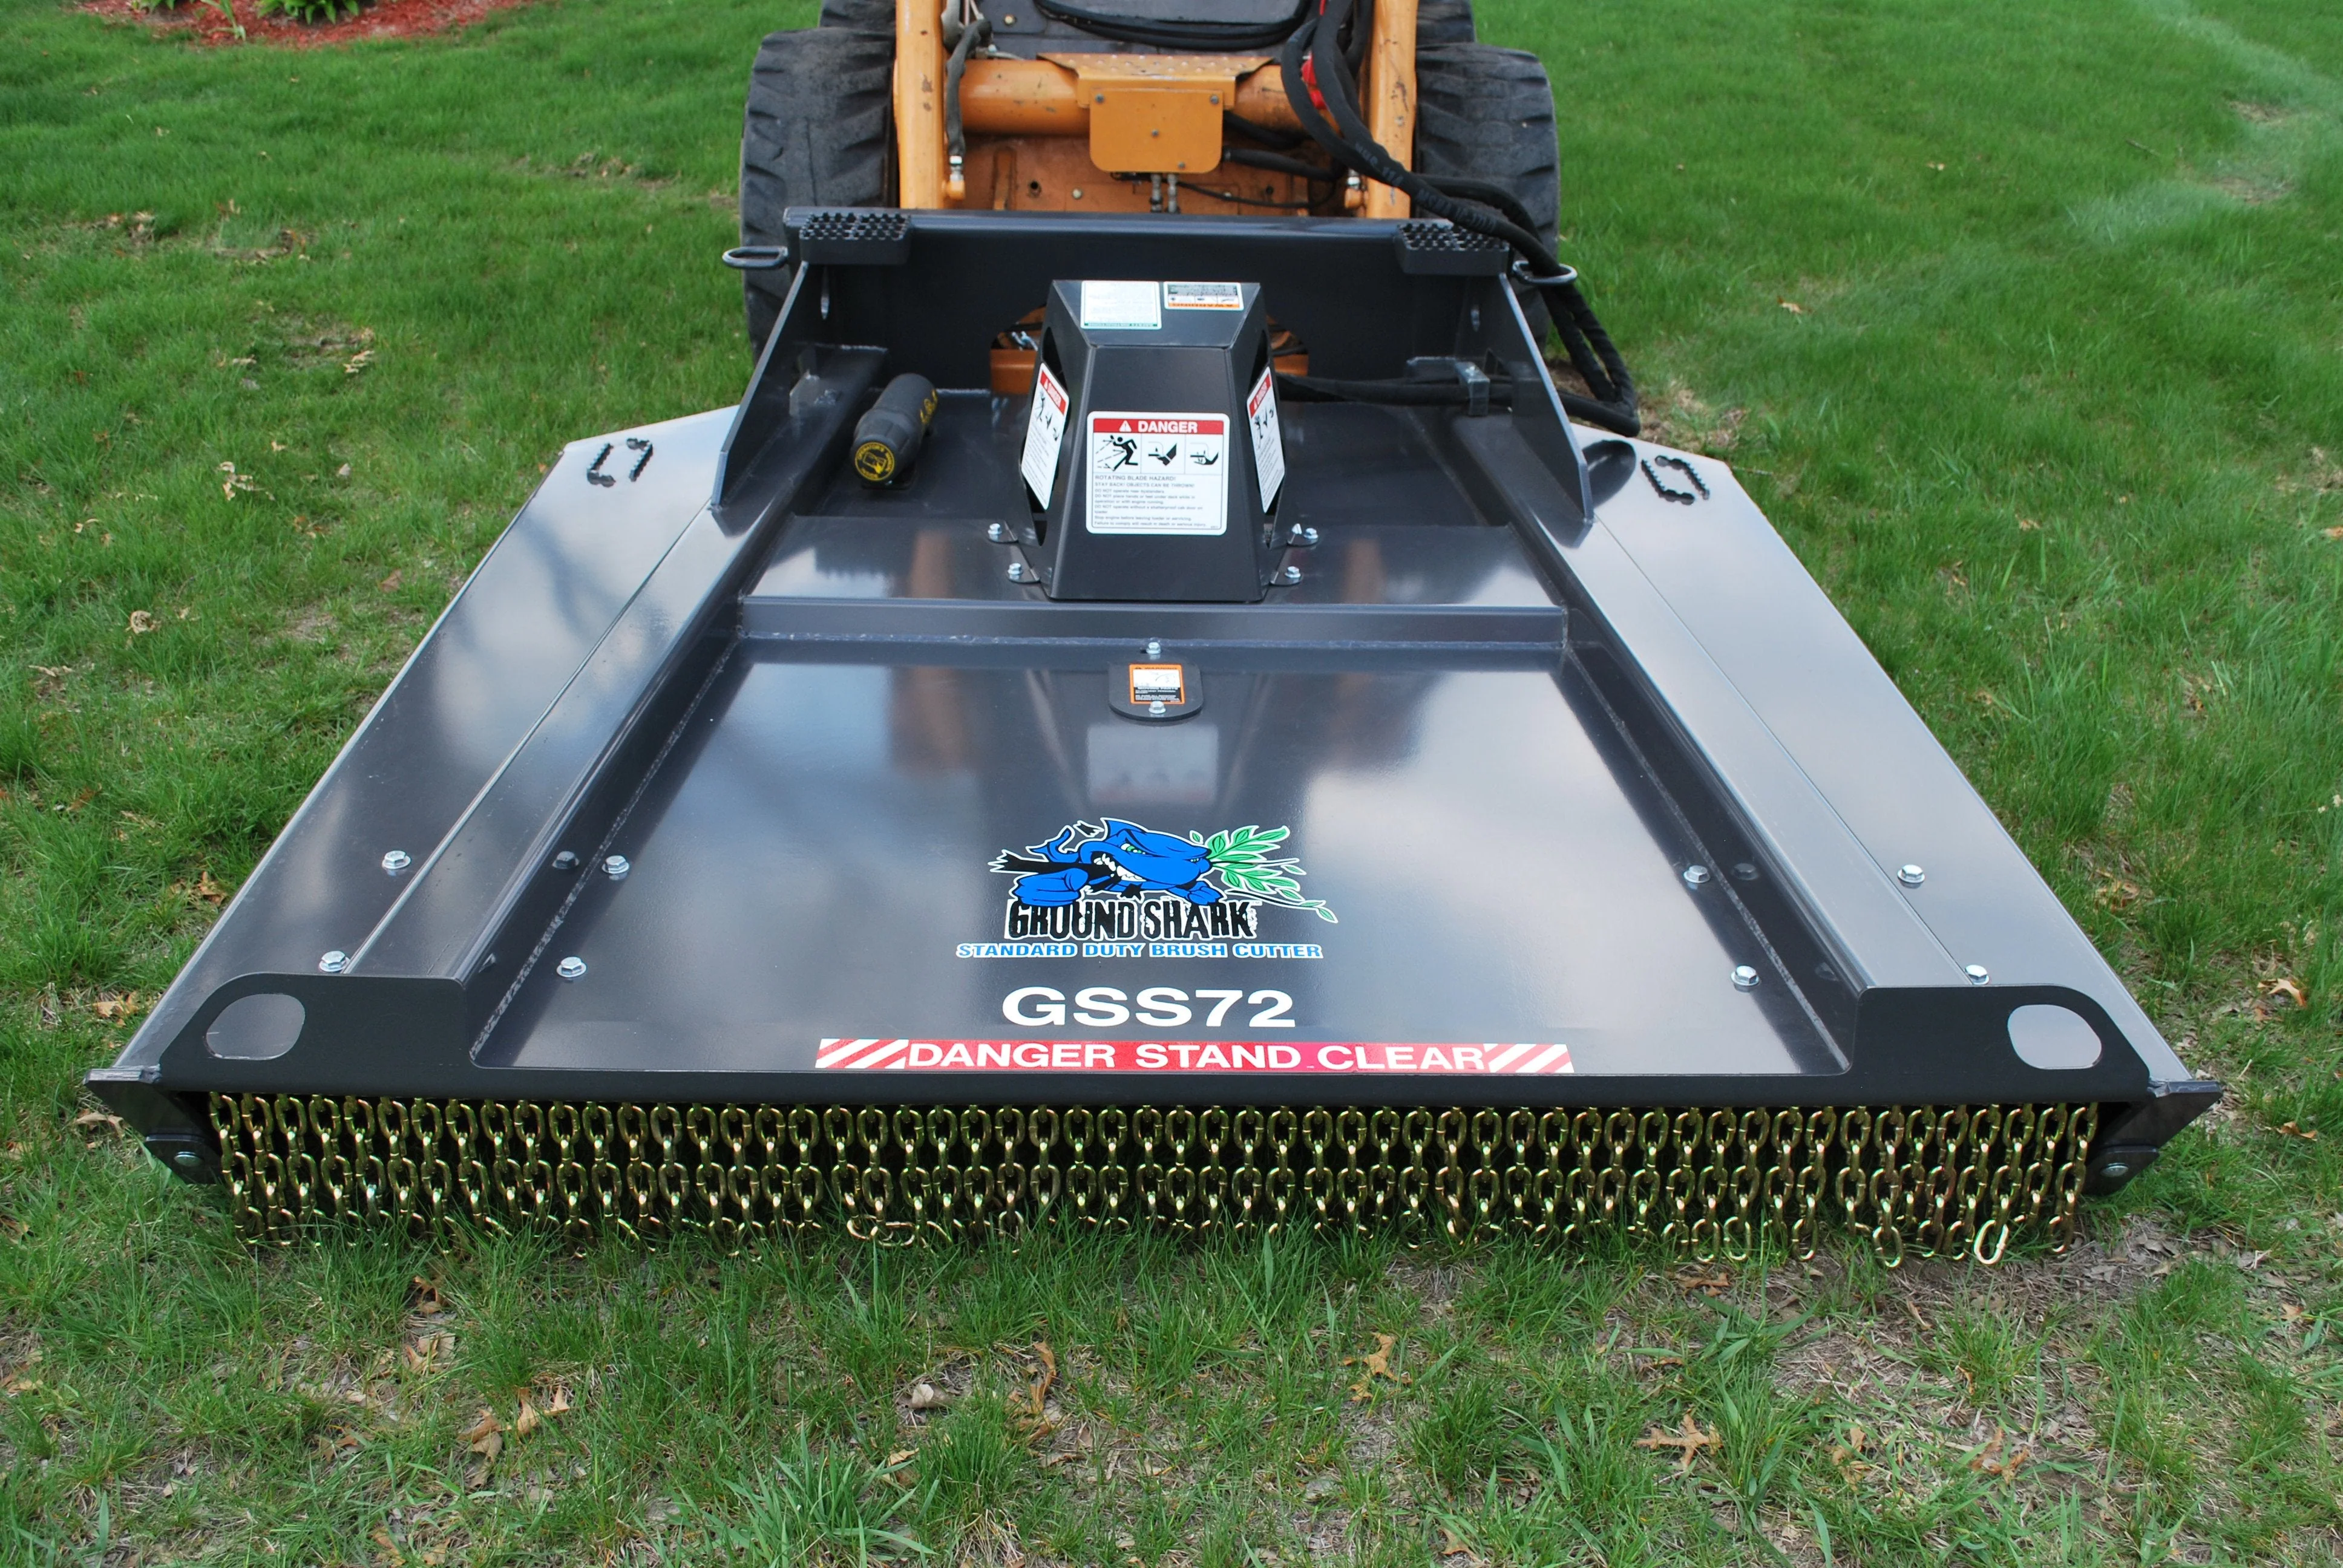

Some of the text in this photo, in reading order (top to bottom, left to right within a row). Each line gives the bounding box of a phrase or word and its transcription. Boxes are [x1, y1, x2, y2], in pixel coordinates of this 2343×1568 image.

[1138, 420, 1198, 433] DANGER
[1007, 900, 1256, 939] GROUND SHARK
[957, 942, 1324, 959] STANDARD DUTY BRUSH CUTTER
[1002, 987, 1296, 1027] GSS72
[909, 1043, 1487, 1070] DANGER STAND CLEAR
